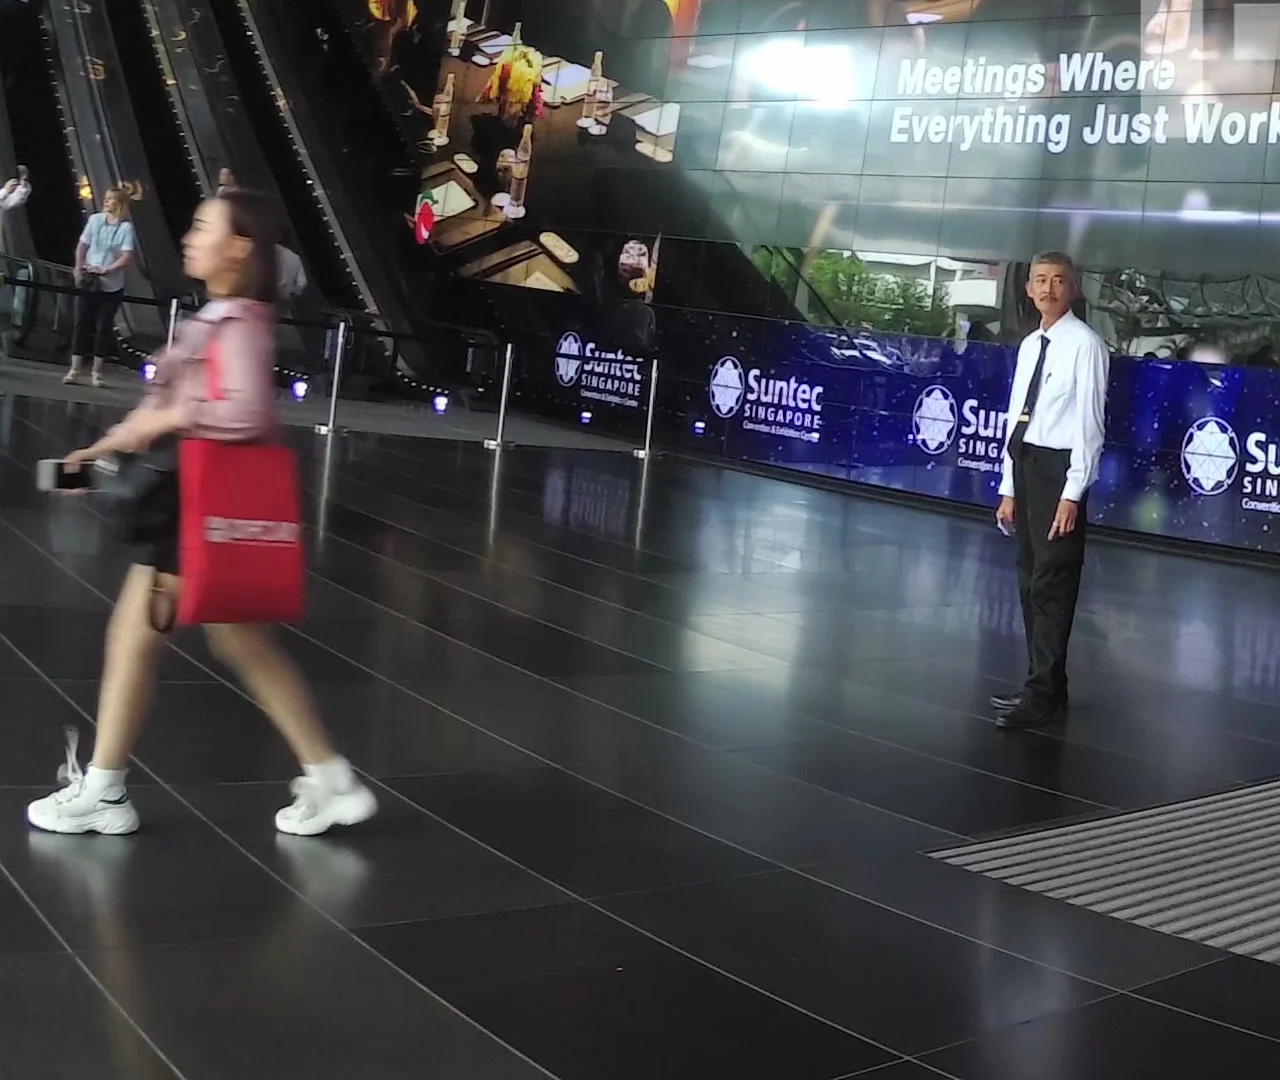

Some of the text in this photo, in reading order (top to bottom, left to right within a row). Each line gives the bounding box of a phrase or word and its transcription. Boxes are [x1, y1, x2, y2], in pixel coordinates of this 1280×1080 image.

[896, 52, 1176, 102] Meetings Where
[889, 103, 1070, 154] Everything
[1082, 103, 1170, 145] Just
[581, 373, 642, 396] SINGAPORE
[746, 368, 824, 412] Suntec
[743, 402, 821, 429] SINGAPORE
